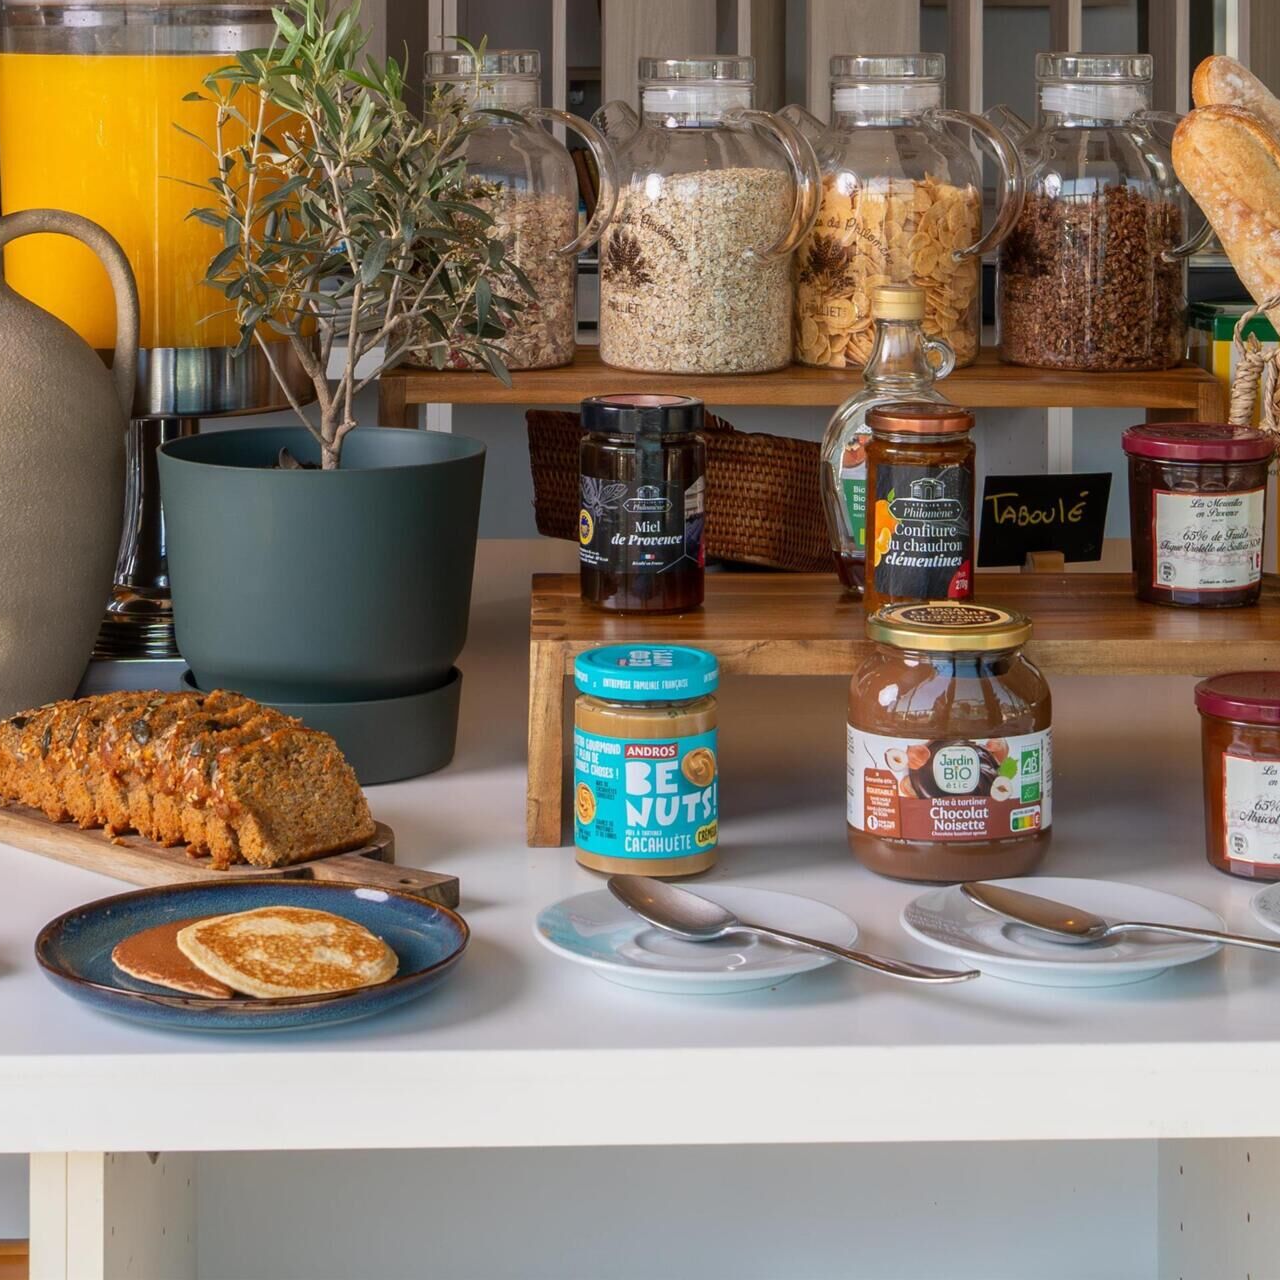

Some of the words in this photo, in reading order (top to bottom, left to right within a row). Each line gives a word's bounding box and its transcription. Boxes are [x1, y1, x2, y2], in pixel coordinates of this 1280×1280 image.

[904, 507, 953, 519] Philomène
[635, 521, 661, 533] Miel
[894, 523, 957, 538] Confiture
[611, 533, 625, 545] de
[628, 534, 682, 546] Provence
[1183, 530, 1208, 541] 65%
[1211, 531, 1222, 542] de
[903, 538, 962, 552] chaudron
[885, 552, 962, 569] clémentines
[626, 745, 676, 757] ANDROS
[940, 753, 974, 767] Jardin
[1262, 766, 1278, 776] Les
[625, 761, 679, 796] BE
[1268, 779, 1278, 787] en
[625, 784, 717, 828] NUTS!
[932, 798, 949, 807] Pâte
[959, 798, 987, 807] tartiner
[930, 806, 989, 820] Chocolat
[934, 819, 986, 832] Noisette
[625, 833, 692, 853] CACAHUÈTE
